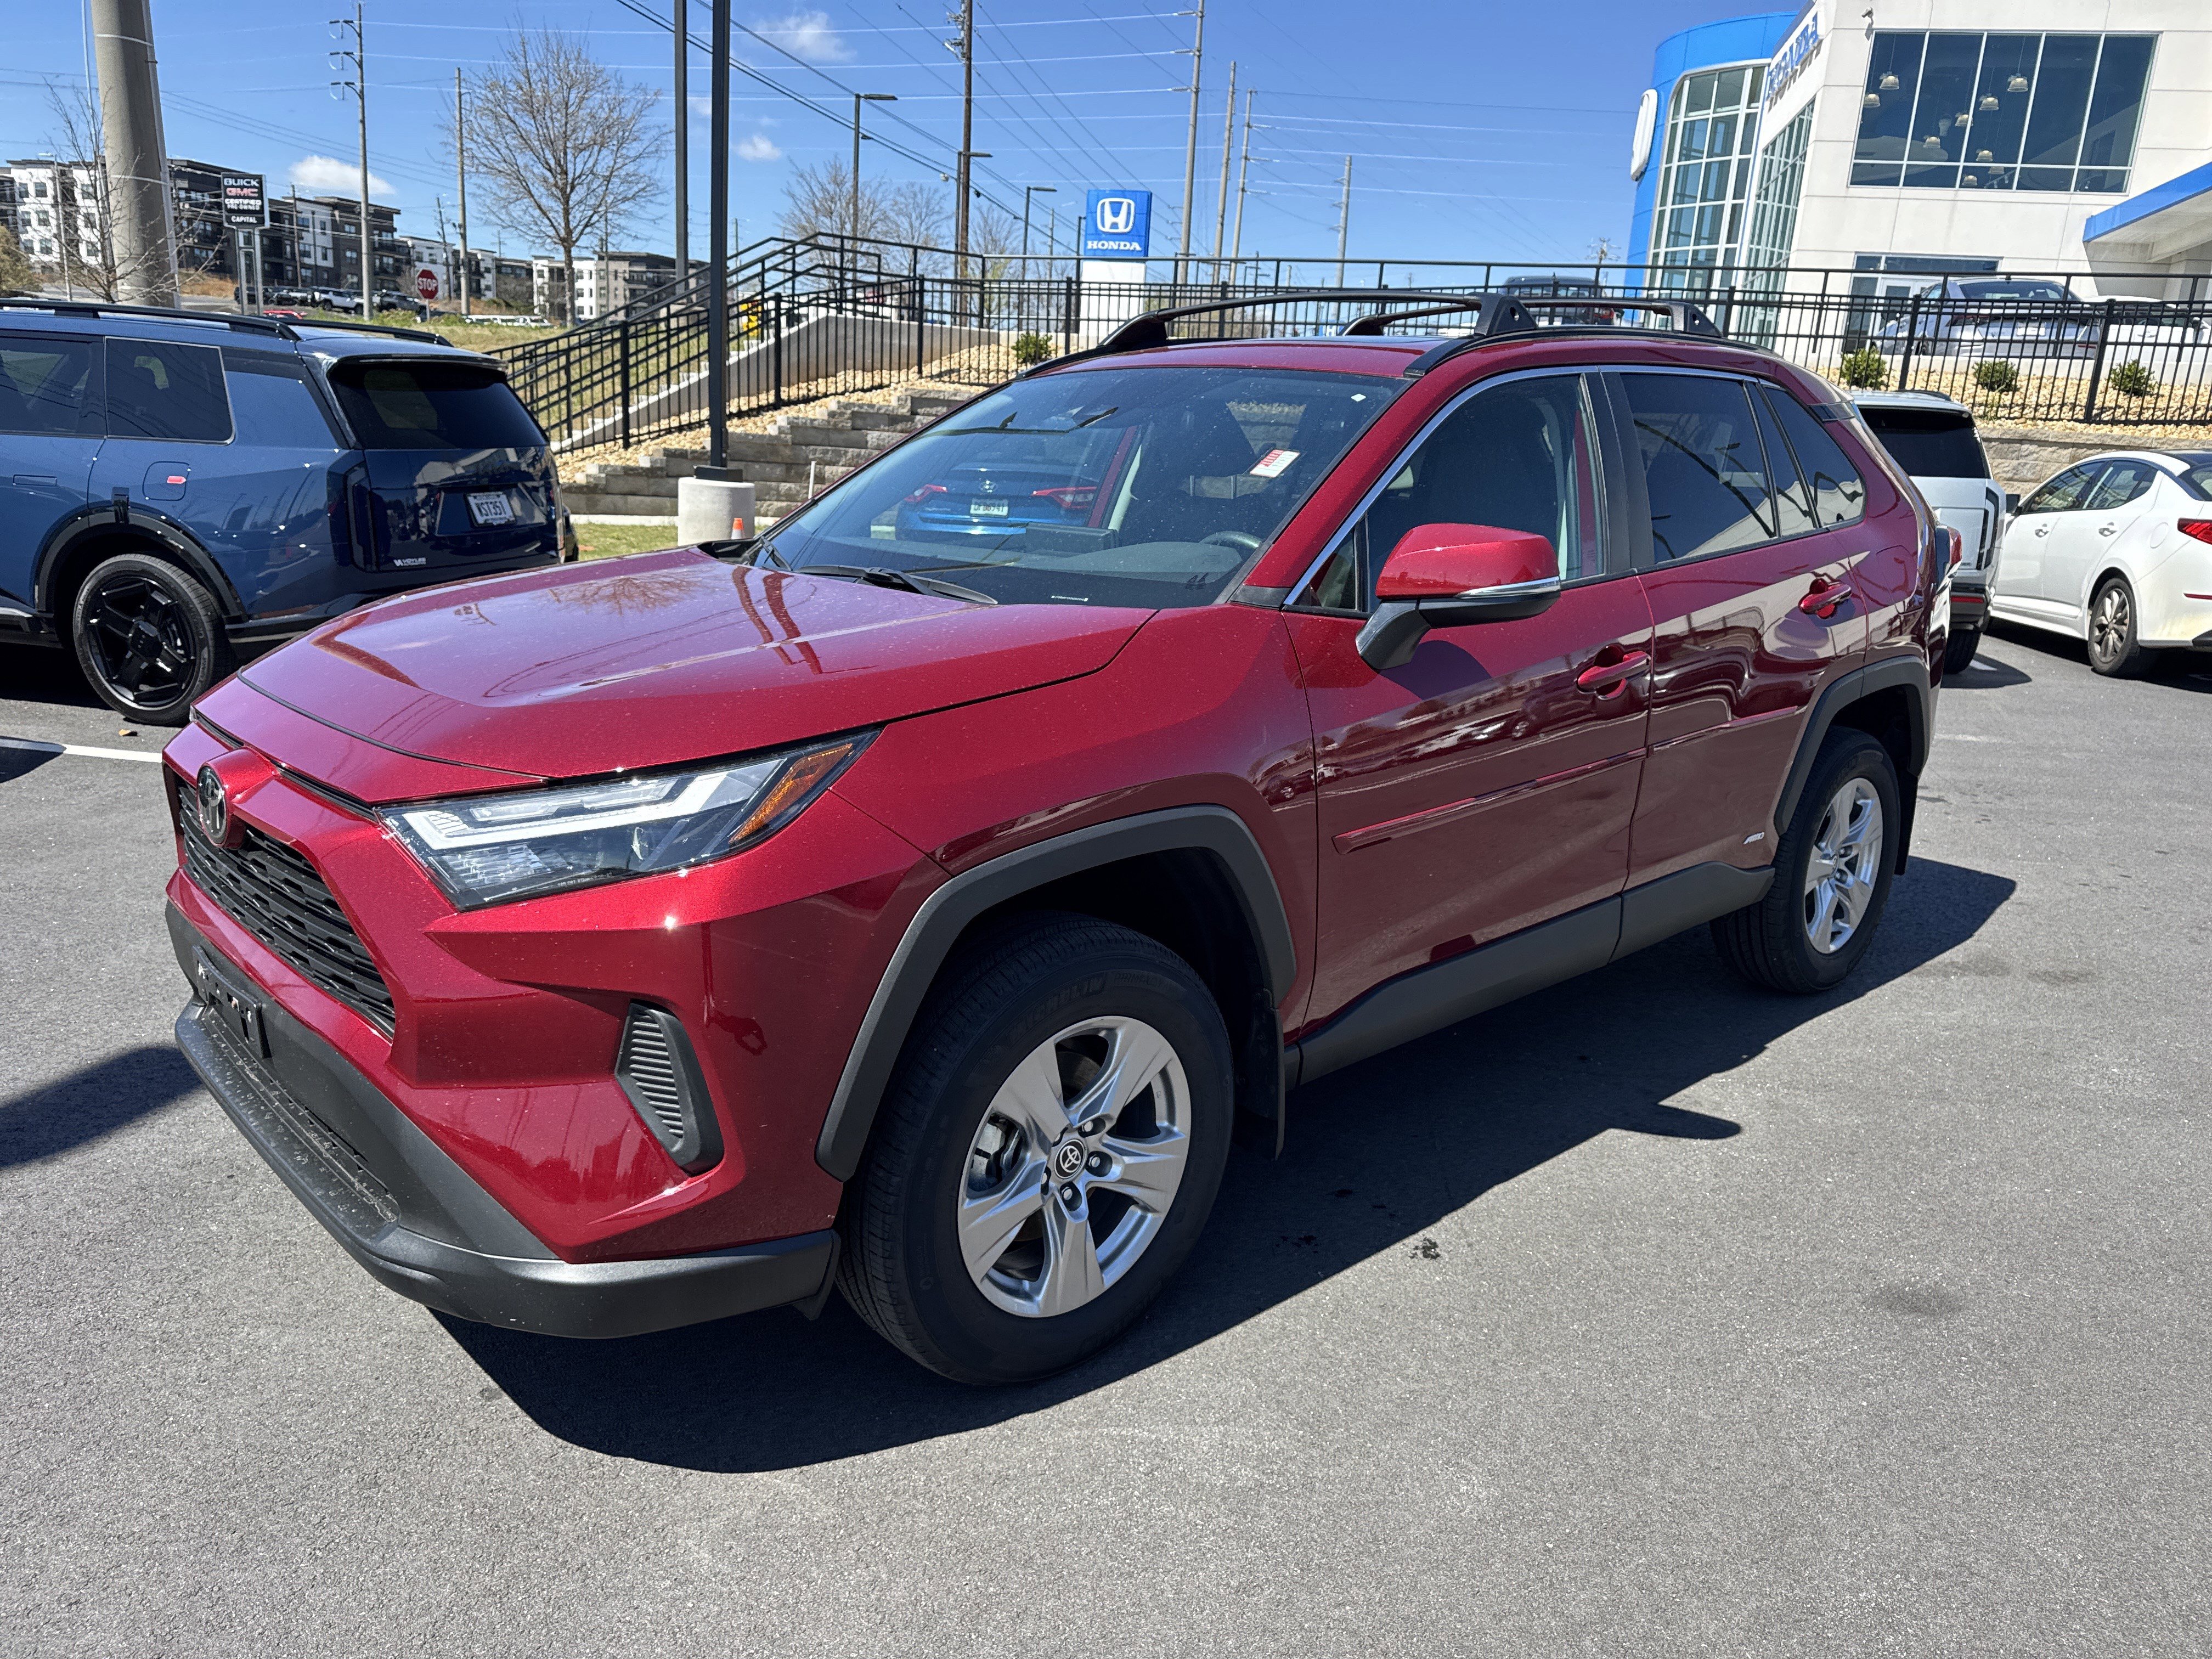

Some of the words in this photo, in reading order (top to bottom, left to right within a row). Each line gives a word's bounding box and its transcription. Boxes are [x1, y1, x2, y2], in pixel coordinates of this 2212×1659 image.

[224, 178, 260, 187] BUICK
[226, 187, 258, 196] GMC
[1087, 240, 1142, 251] HONDA
[417, 277, 437, 291] STOP
[1006, 977, 1102, 1043] MICHELIN
